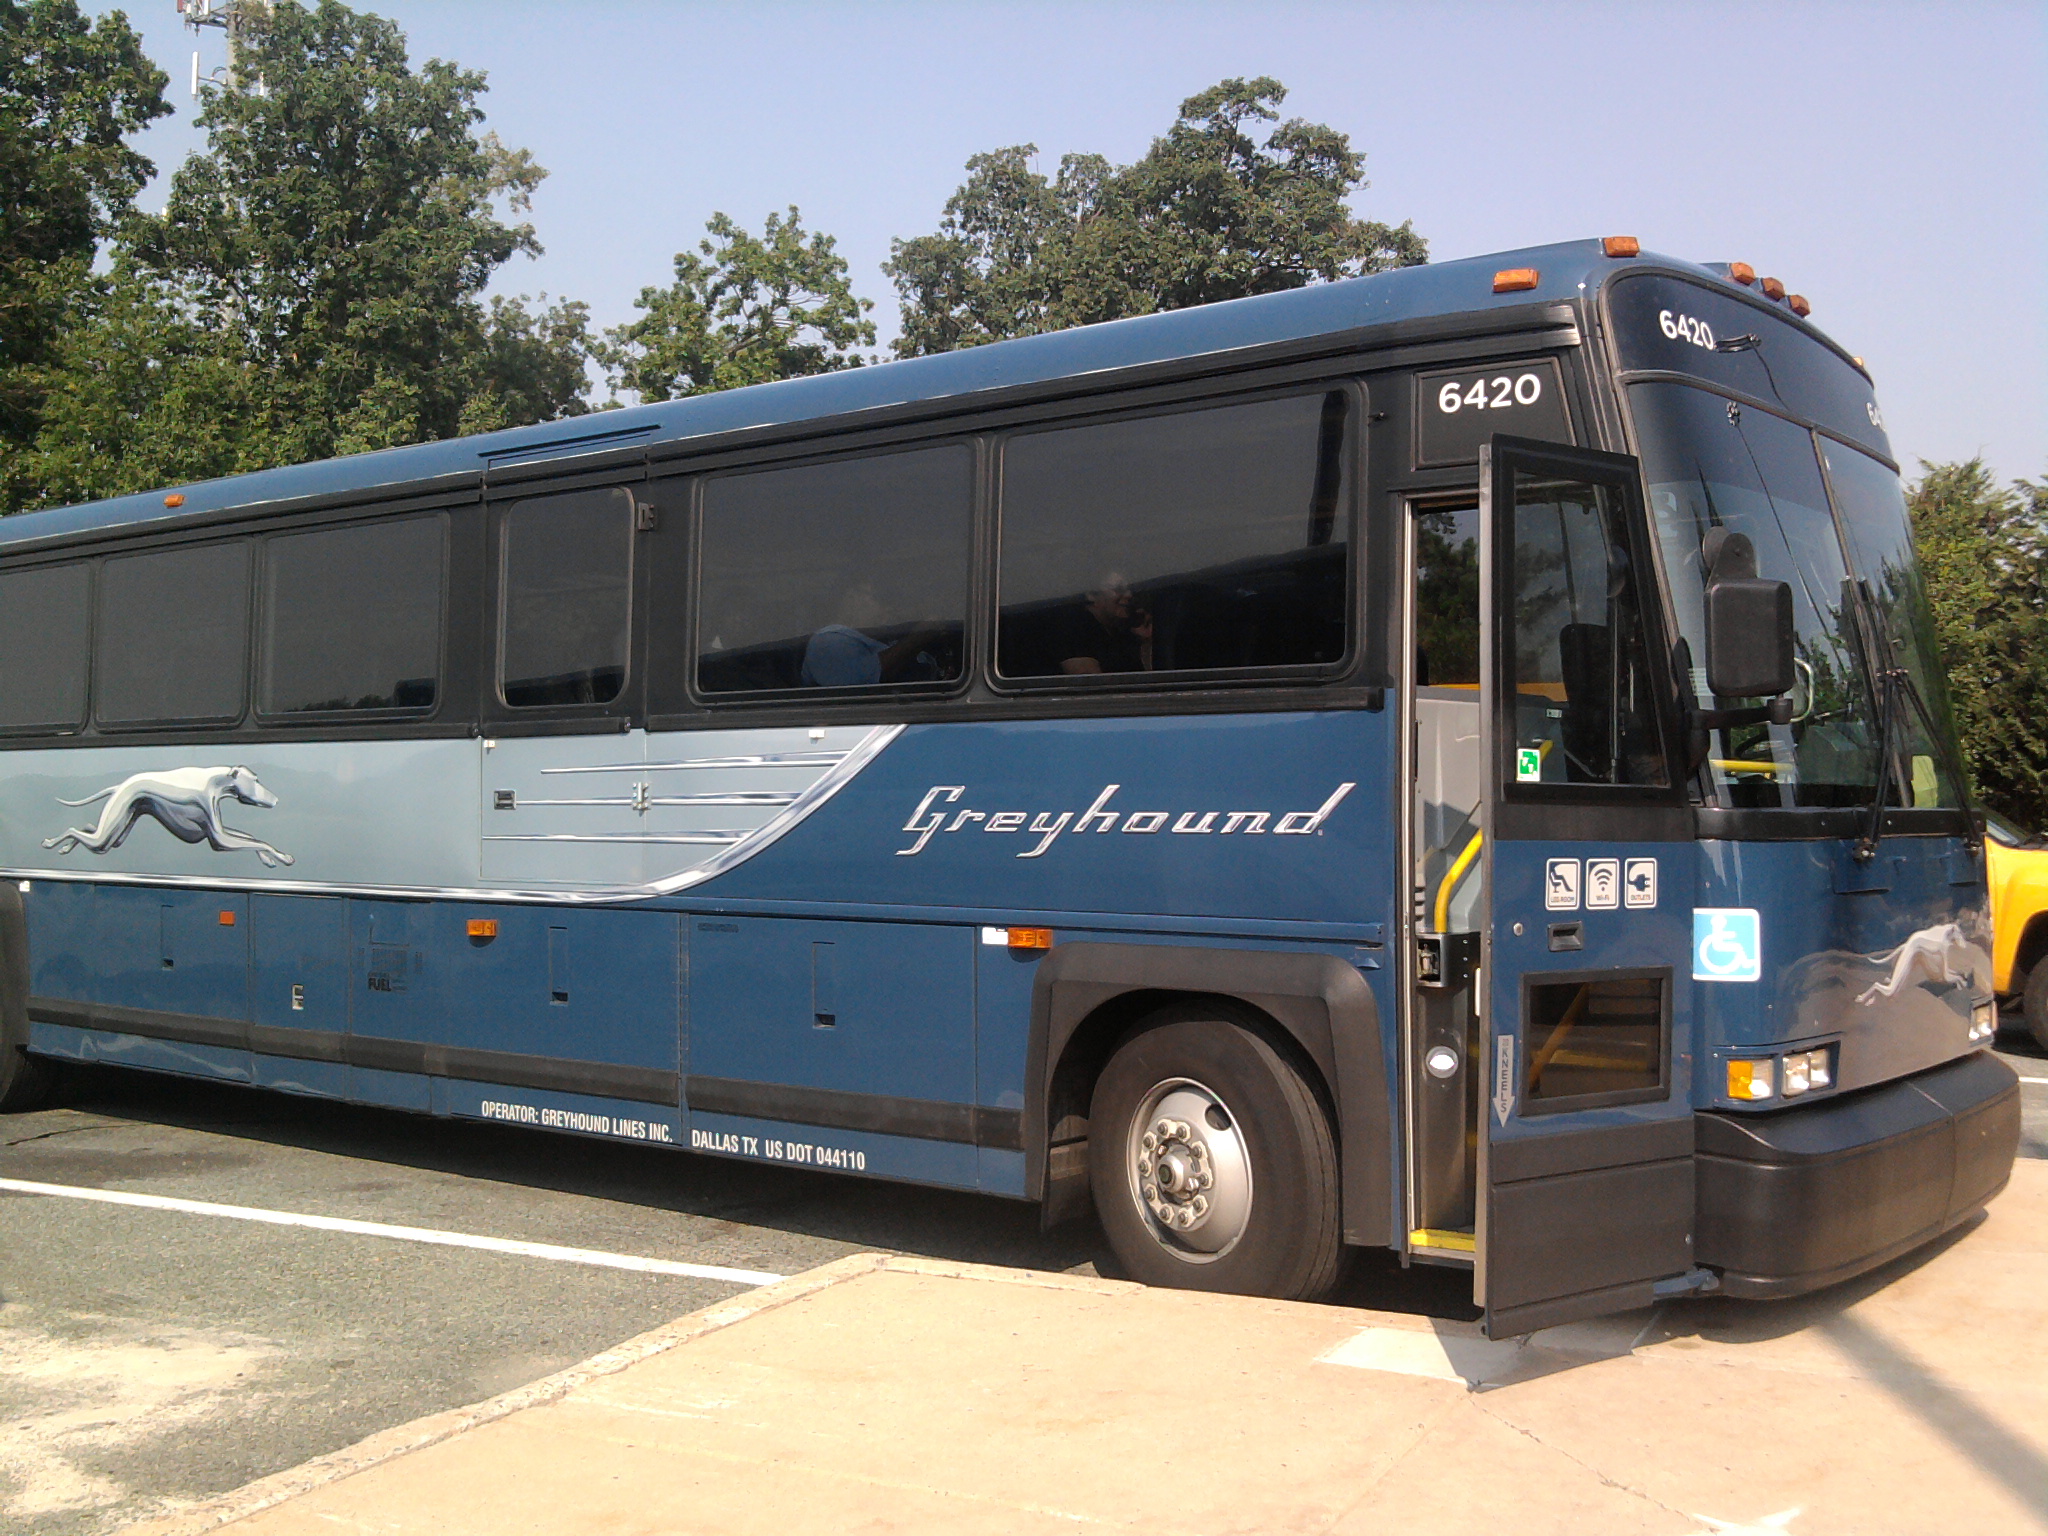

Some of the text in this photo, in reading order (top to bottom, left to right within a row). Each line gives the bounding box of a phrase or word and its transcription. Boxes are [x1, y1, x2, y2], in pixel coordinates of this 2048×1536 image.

[1659, 310, 1714, 350] 6420
[1438, 373, 1541, 413] 6420
[895, 782, 1357, 859] Greyhound
[368, 977, 392, 992] FUEL
[1500, 1048, 1509, 1113] KNEELS
[481, 1099, 673, 1143] OPERATOR: GREYHOUND LINES INC.
[691, 1128, 866, 1171] DALLAS TX US DOT 044110
